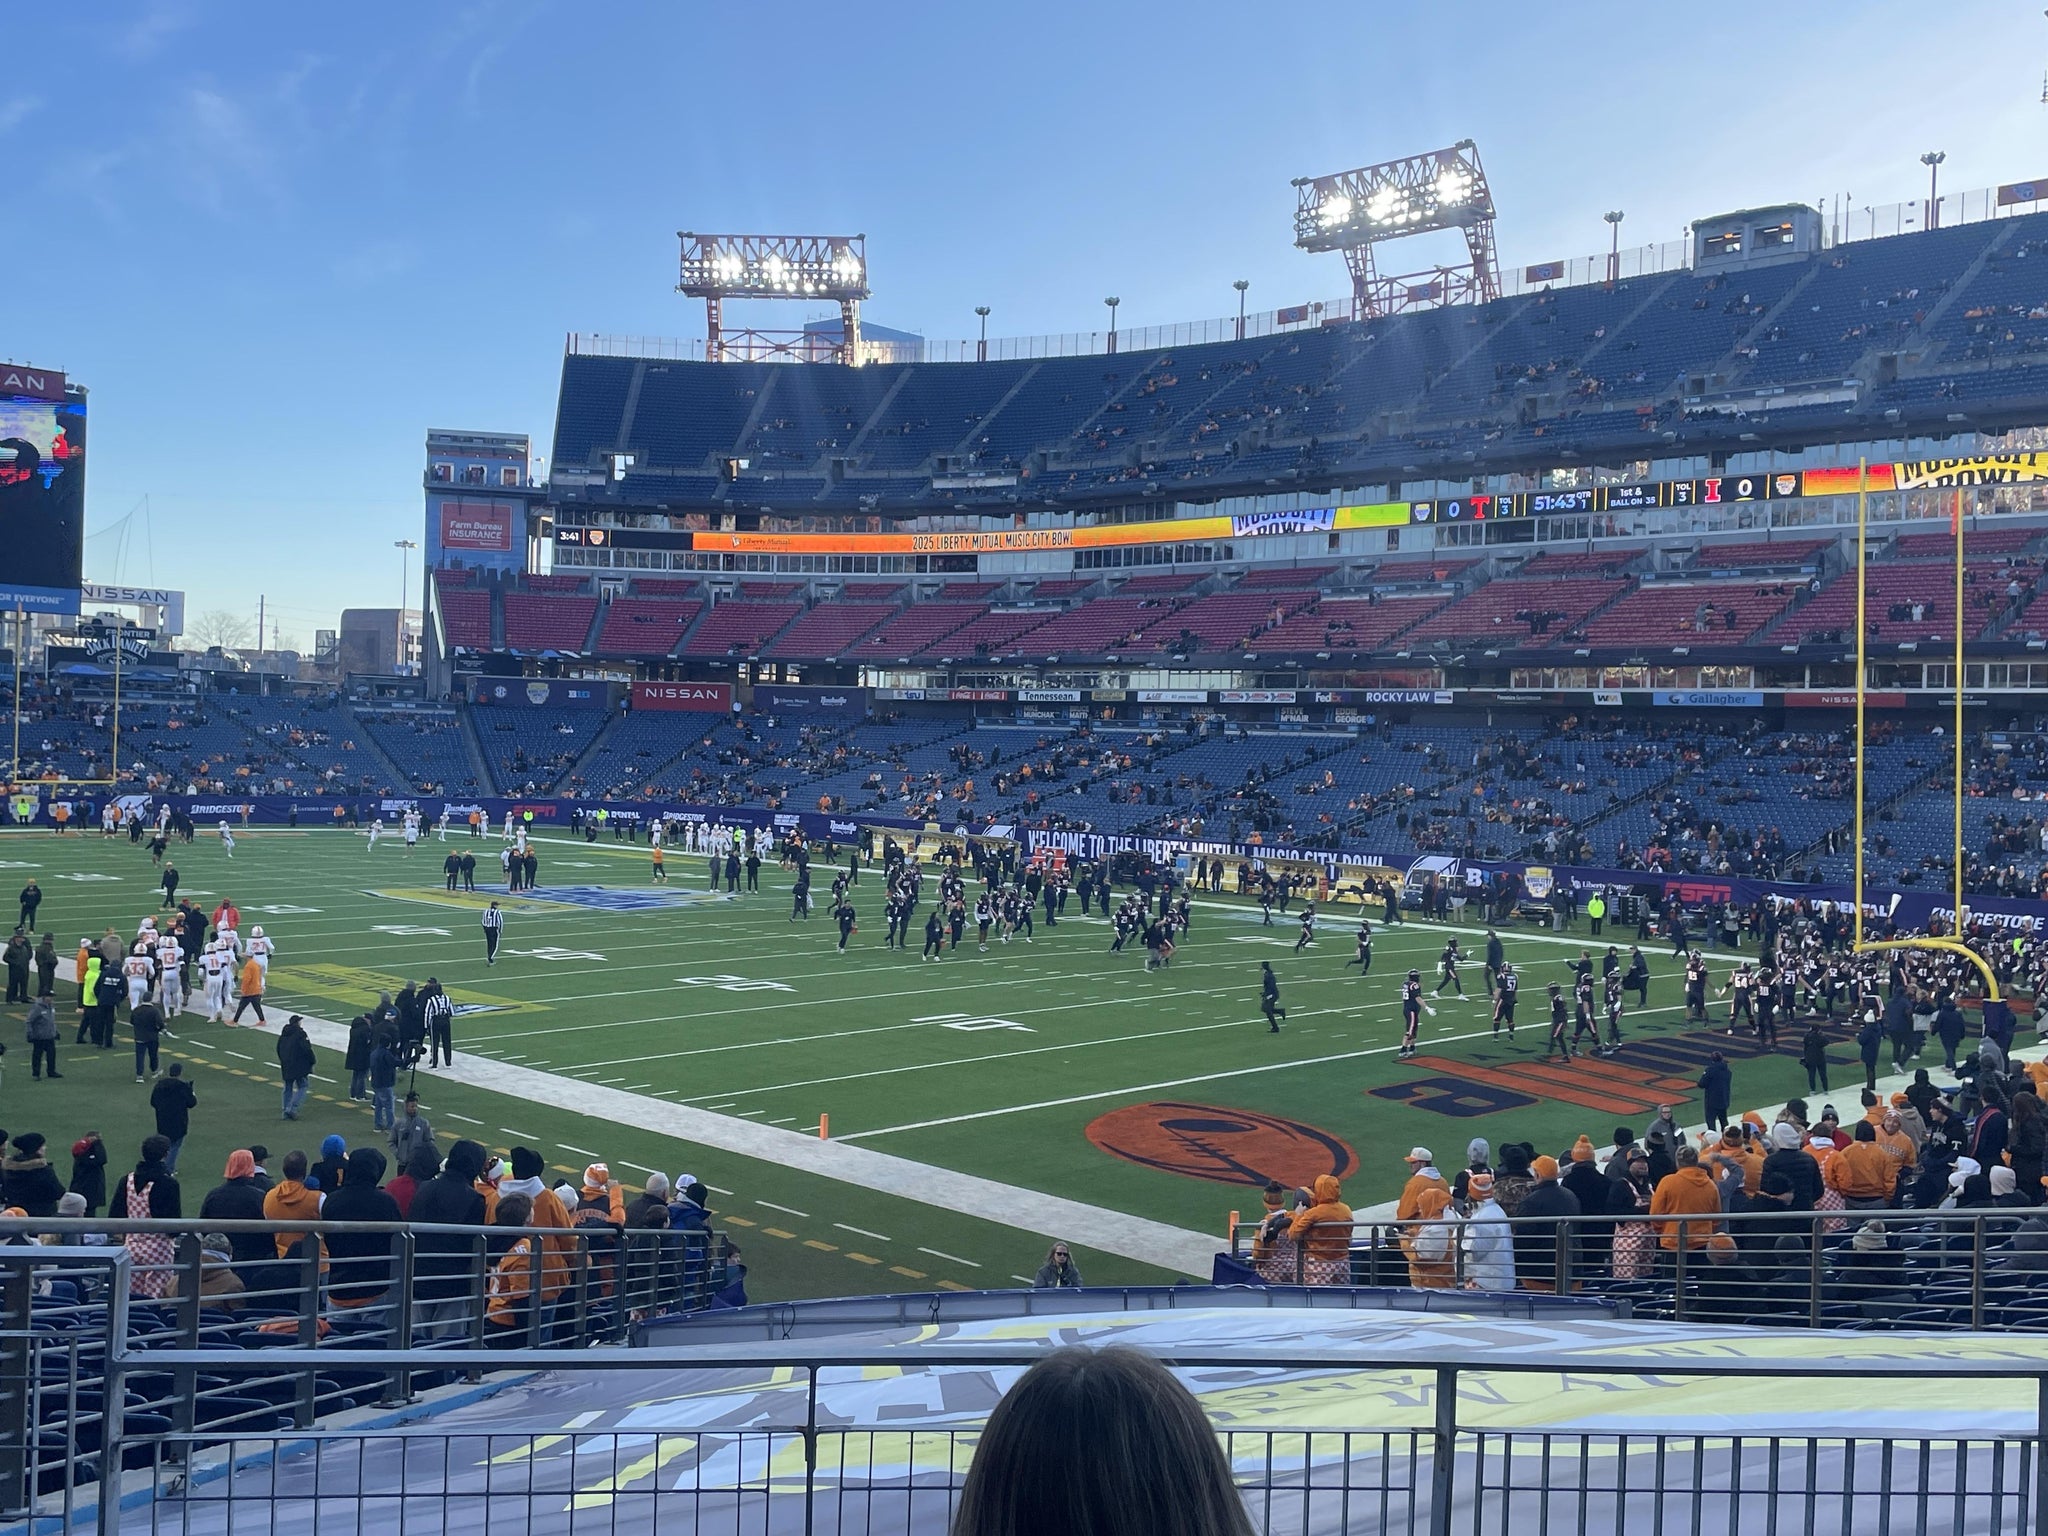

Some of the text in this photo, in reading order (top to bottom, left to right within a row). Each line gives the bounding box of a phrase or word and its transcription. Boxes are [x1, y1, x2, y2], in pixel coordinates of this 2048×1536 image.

[1676, 483, 1691, 491] TOL
[1738, 479, 1752, 497] 0
[1575, 490, 1592, 499] QTR
[1679, 493, 1687, 502] 3
[1498, 497, 1512, 505] TOL
[1534, 493, 1577, 511] 51:43
[1610, 498, 1630, 507] BALL
[1631, 498, 1643, 506] ON
[1448, 501, 1460, 518] 0
[1501, 505, 1509, 515] 3
[450, 520, 503, 531] Farm Bureau
[449, 530, 503, 539] INSURANCE
[559, 531, 579, 541] 3:41
[912, 531, 1074, 550] 2025 LIBERTY MUTUAL MUSIC CITY BOWL
[645, 687, 719, 700] NISSAN
[1315, 692, 1341, 702] FedEx
[1366, 692, 1430, 702] ROCKY LAW
[1597, 694, 1618, 702] WM
[1689, 694, 1747, 705] Gallagher
[1281, 707, 1304, 715] STEVE
[1335, 715, 1367, 723] GEORGE
[190, 804, 255, 814] BRIDGESTOE
[1028, 830, 1086, 858] WELCOME
[1089, 834, 1105, 859] TO
[1136, 838, 1188, 865] LIBERTY
[1582, 880, 1605, 891] Liberty
[1665, 882, 1732, 903] ESPN
[163, 952, 176, 964] 13
[129, 962, 146, 976] 33
[1784, 974, 1796, 985] 21
[1864, 979, 1871, 991] 9
[1506, 979, 1517, 992] 57
